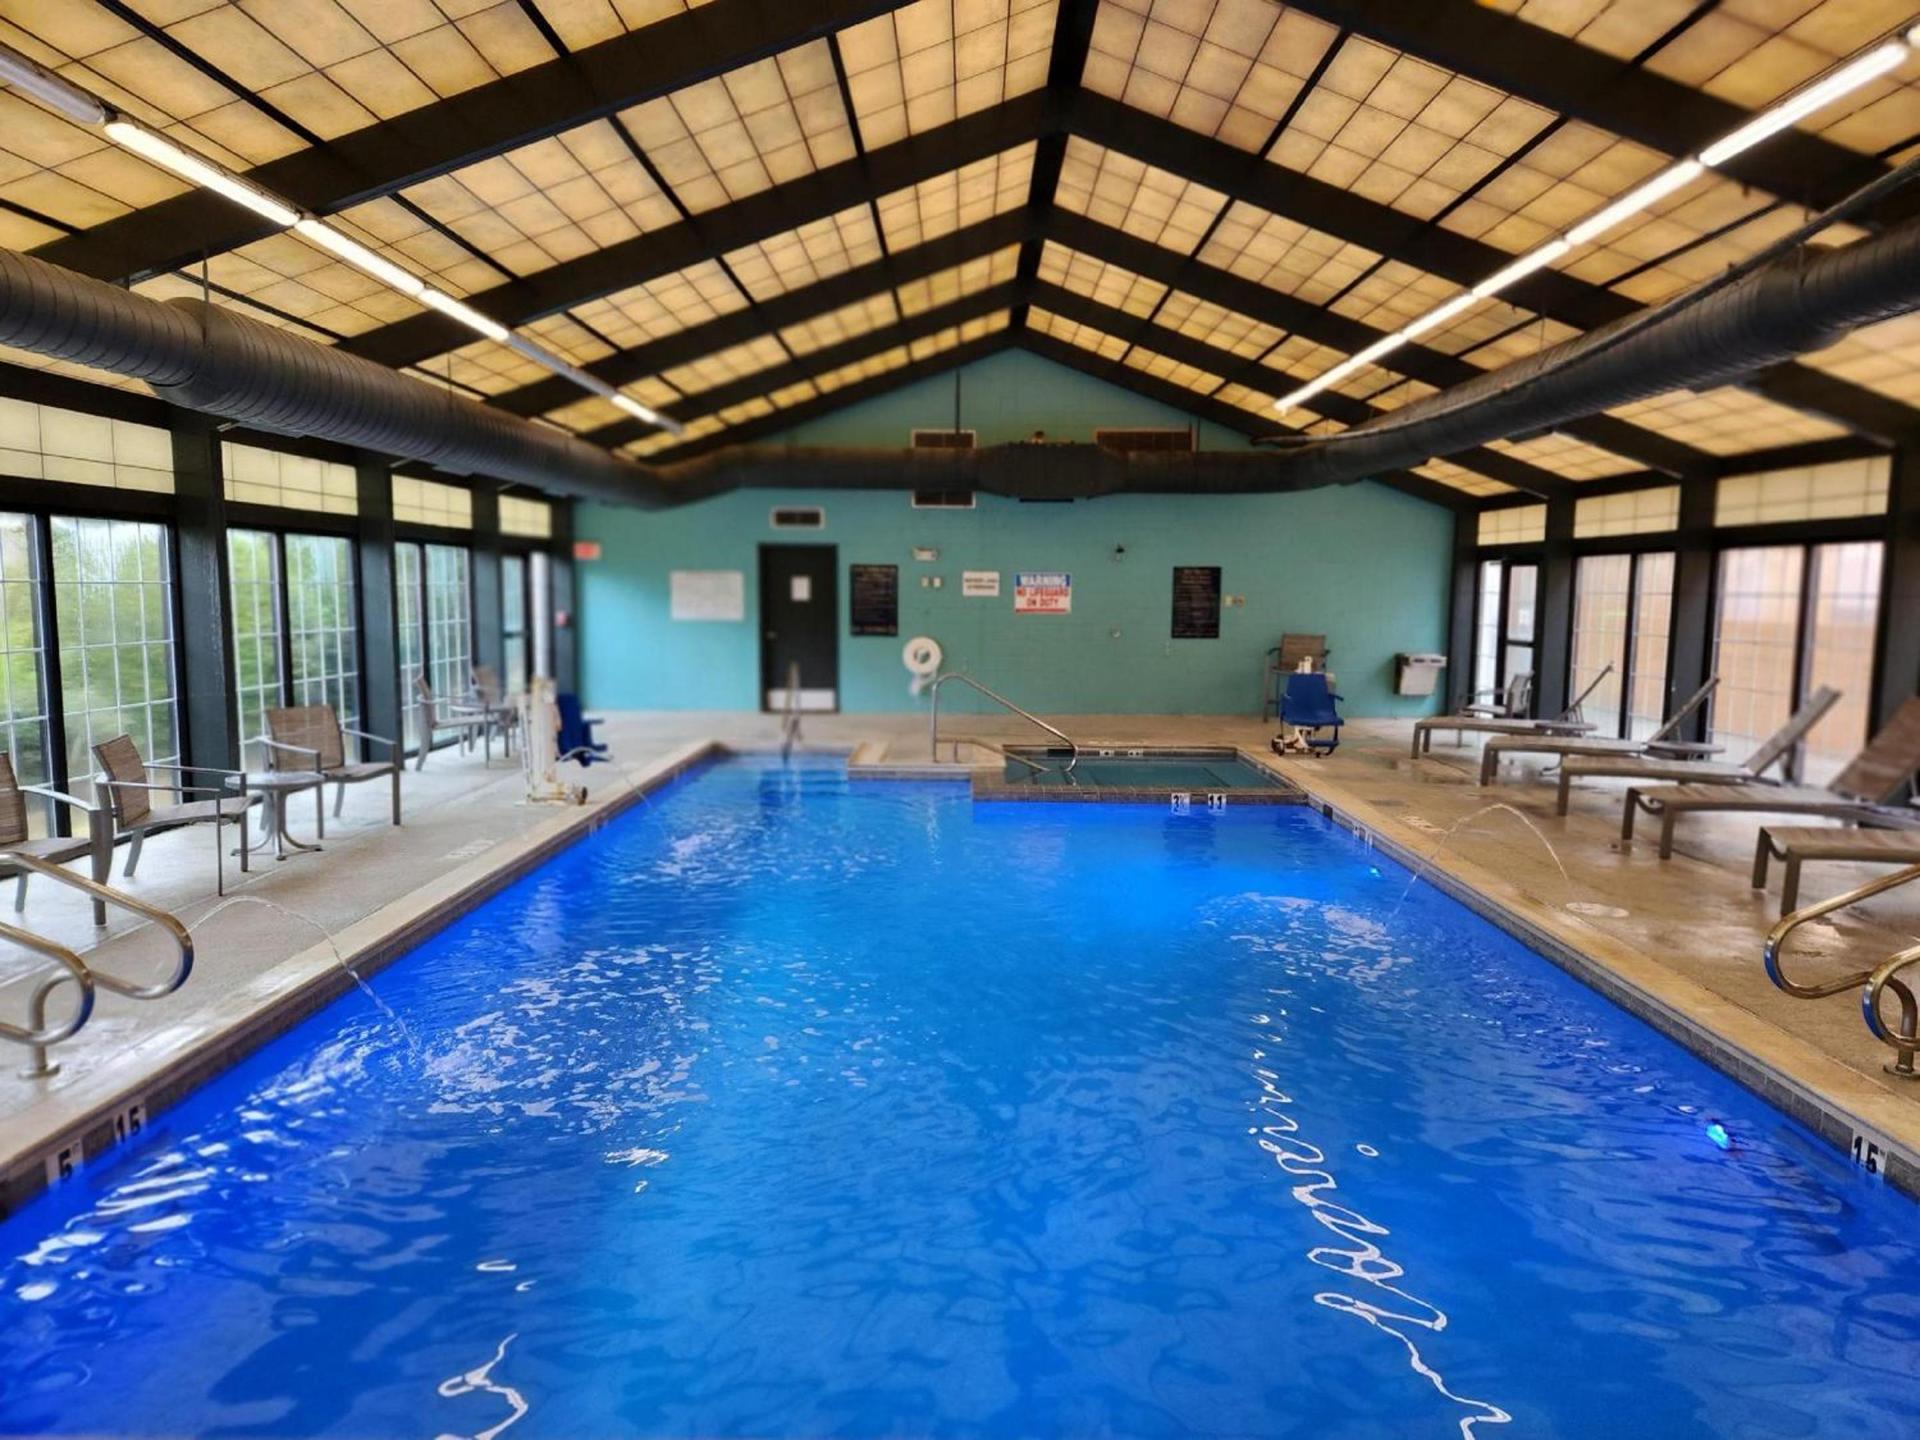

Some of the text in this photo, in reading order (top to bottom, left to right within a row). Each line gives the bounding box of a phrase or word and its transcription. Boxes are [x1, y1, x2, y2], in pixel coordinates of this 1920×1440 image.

[1021, 574, 1066, 587] WARNING
[1026, 598, 1058, 607] ON DUTY
